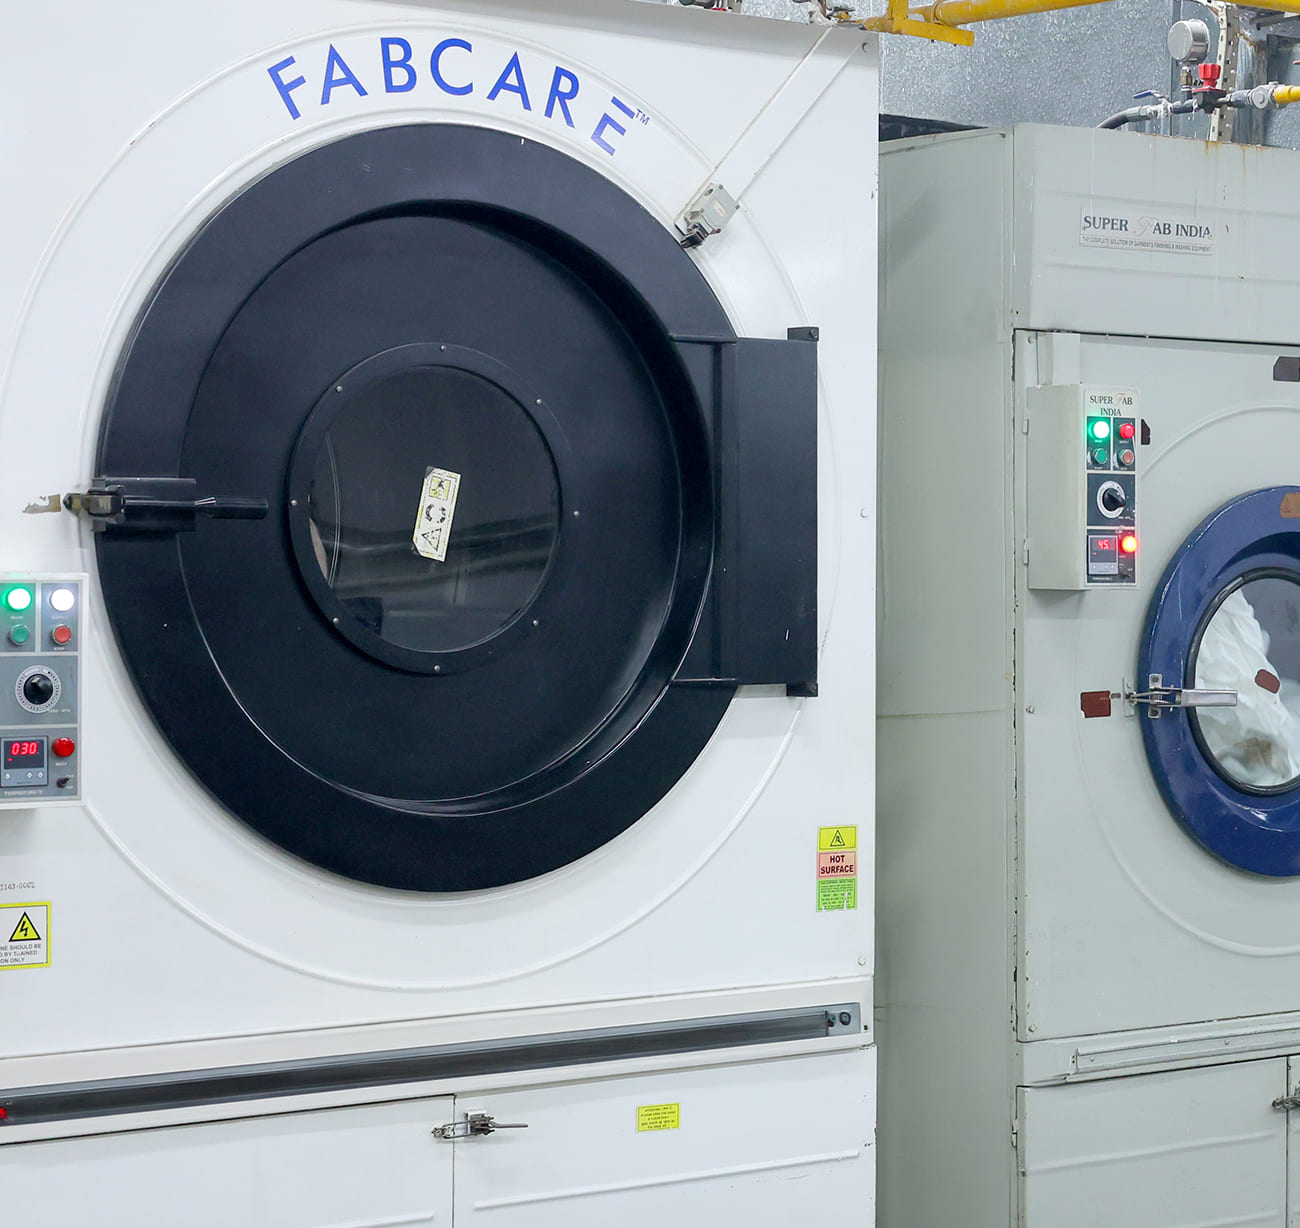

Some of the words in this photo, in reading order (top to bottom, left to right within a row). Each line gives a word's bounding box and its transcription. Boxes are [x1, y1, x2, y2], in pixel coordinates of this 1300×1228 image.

[267, 37, 636, 156] FABCARE
[1083, 215, 1129, 231] SUPER
[1175, 223, 1211, 239] INDIA
[1089, 395, 1113, 405] SUPER
[1100, 407, 1122, 417] INDIA
[11, 741, 39, 756] 030
[830, 855, 845, 864] HOT
[820, 865, 854, 875] SURFACE
